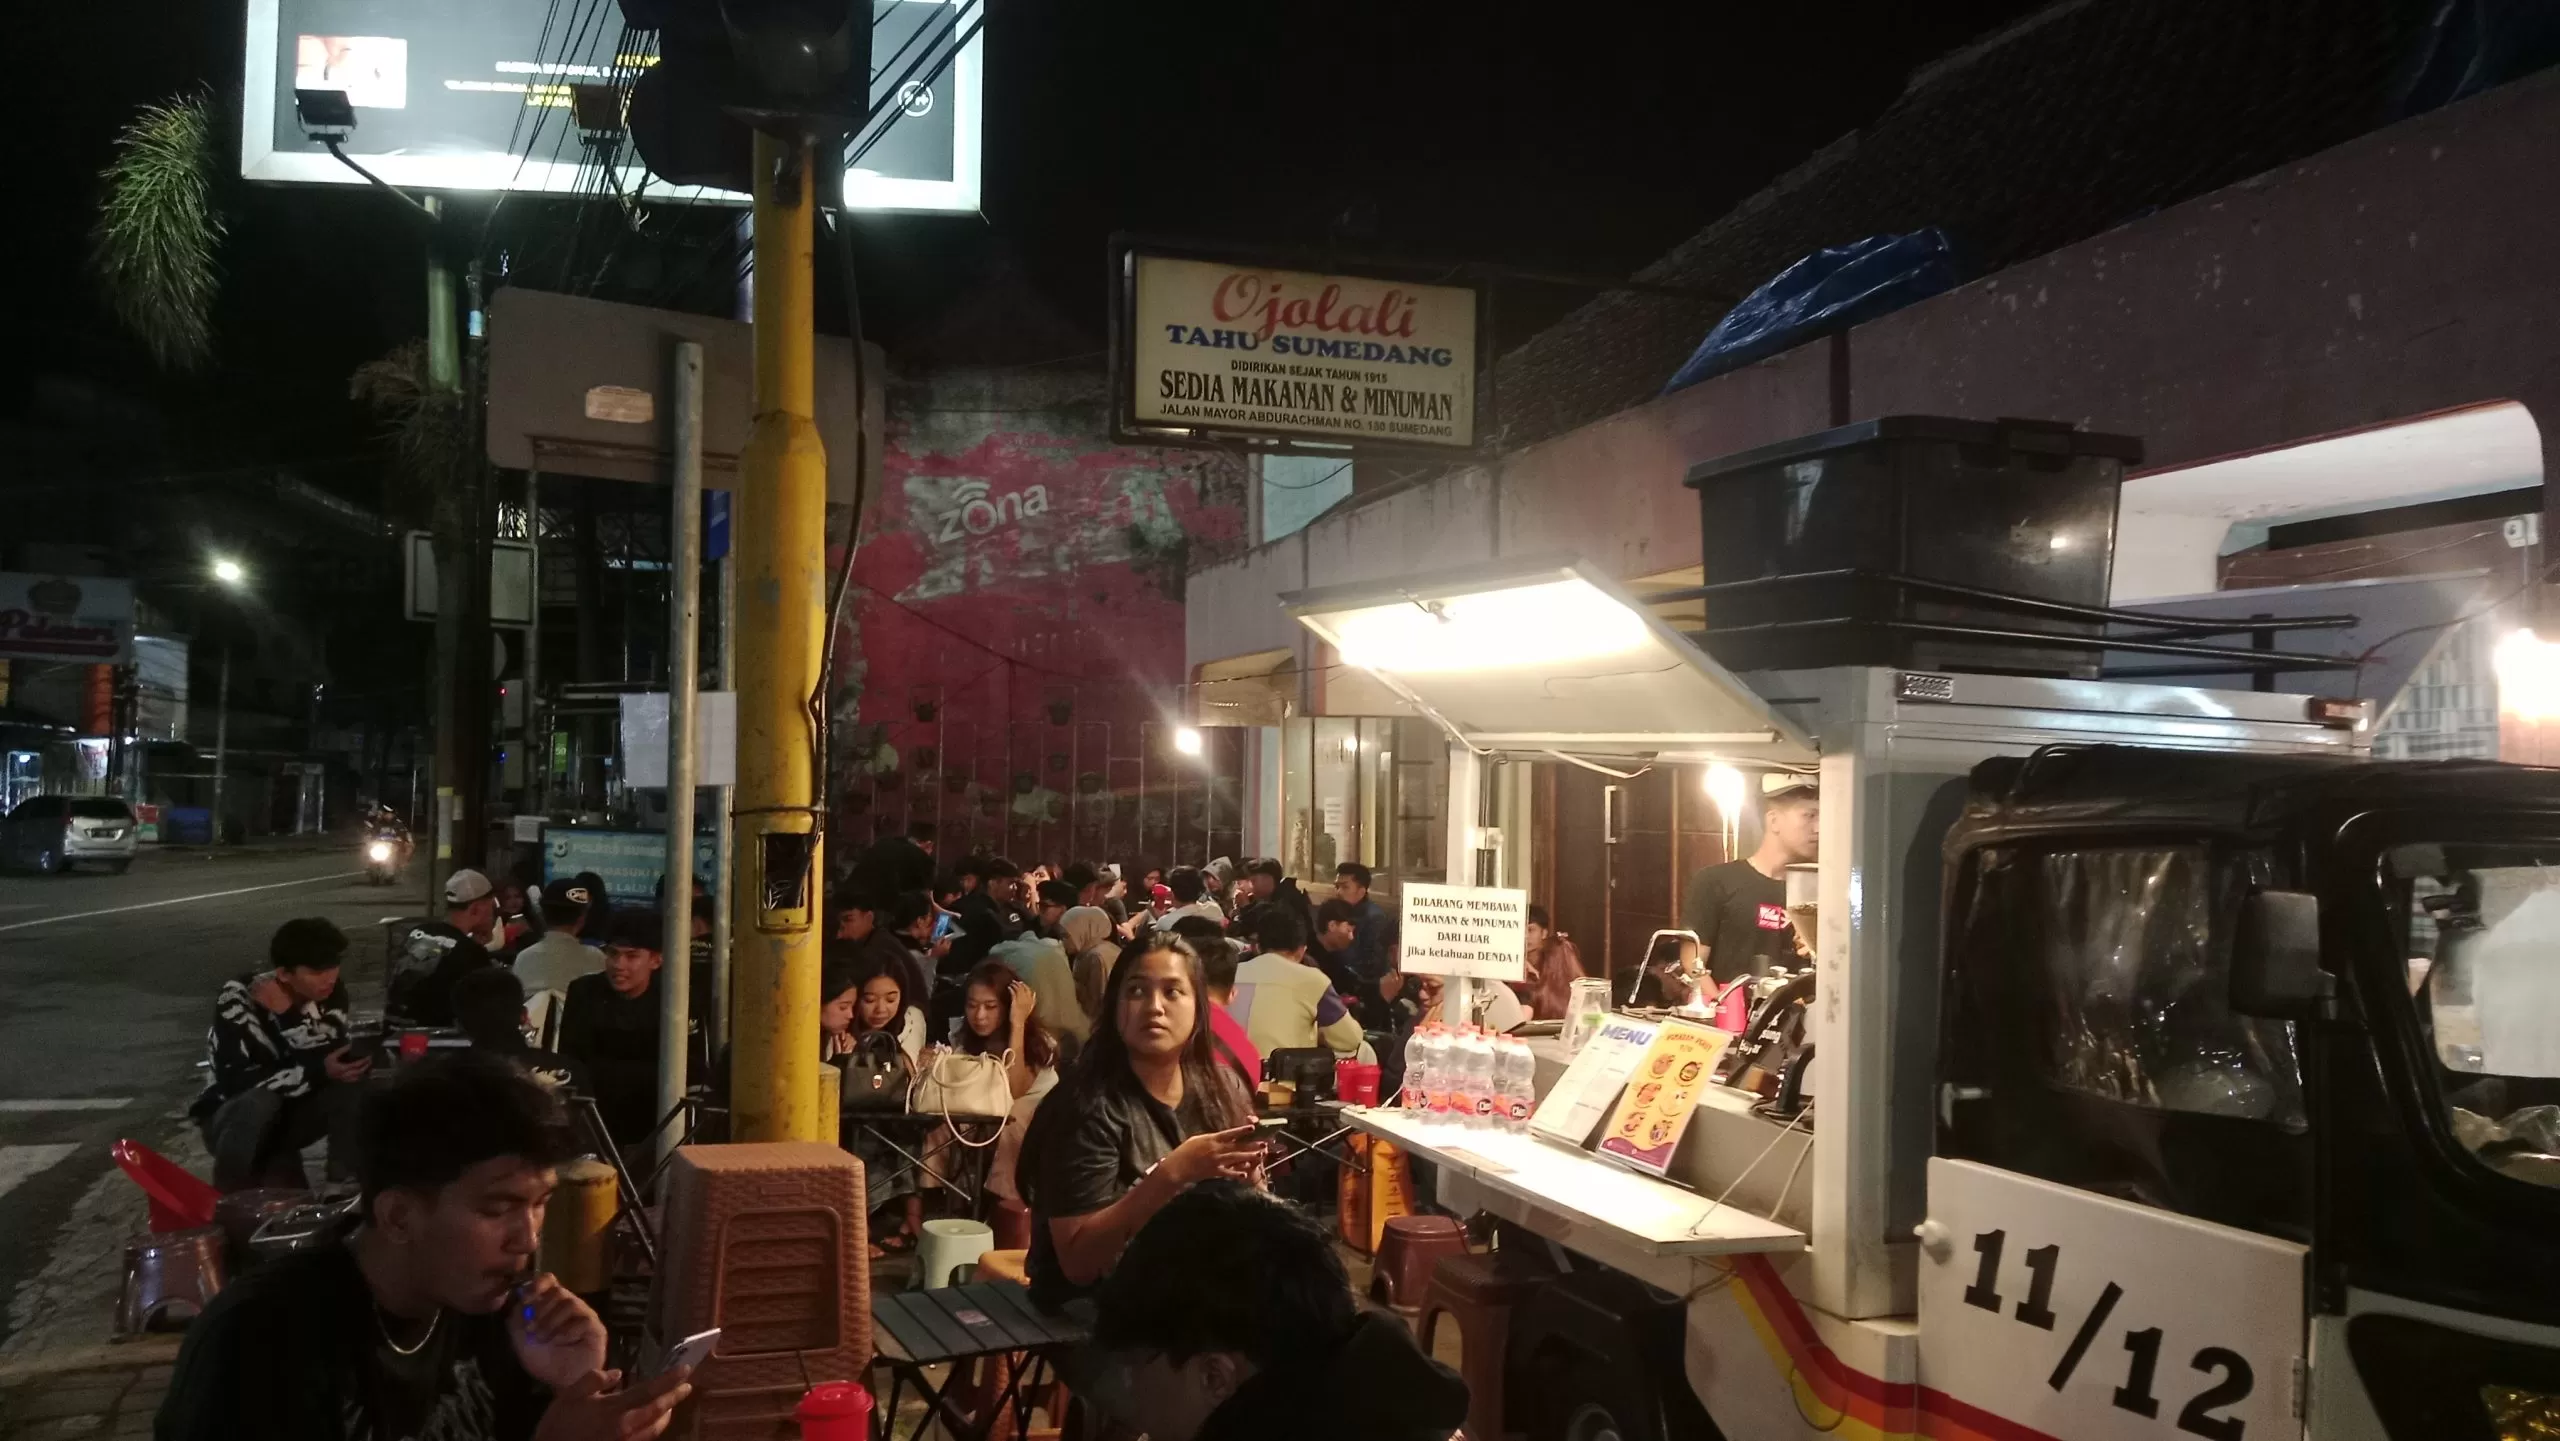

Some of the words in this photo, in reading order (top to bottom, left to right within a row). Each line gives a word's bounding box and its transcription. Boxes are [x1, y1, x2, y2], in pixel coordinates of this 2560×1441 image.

[1212, 274, 1418, 341] Ojolali
[1165, 324, 1260, 350] TAHU
[1272, 335, 1453, 367] SUMEDANG
[1231, 360, 1286, 375] DIDIRIKAN
[1289, 365, 1322, 377] SEJAK
[1326, 368, 1360, 381] TAHUN
[1364, 372, 1387, 383] 1915
[1160, 369, 1225, 403] SEDIA
[1231, 376, 1334, 412] MAKANAN
[1341, 385, 1358, 413] &
[1363, 387, 1453, 421] MINUMAN
[1160, 404, 1200, 417] JALAN
[1203, 407, 1246, 420] MAYOR
[1248, 411, 1340, 428] ABDURACHMAN
[1389, 421, 1453, 437] SUMEDANG
[1413, 897, 1463, 910] DILARANG
[1466, 900, 1518, 913] MEMBAWA
[1410, 913, 1457, 926] MAKANAN
[1460, 917, 1469, 926] &
[1472, 917, 1519, 929] MINUMAN
[1437, 931, 1461, 942] DARI
[1464, 933, 1490, 944] LUAR
[1407, 946, 1426, 958] jika
[1429, 947, 1474, 960] ketahuan
[1477, 951, 1512, 963] DENDA
[1599, 1023, 1652, 1046] MENU
[1964, 1229, 2255, 1441] 11/12
